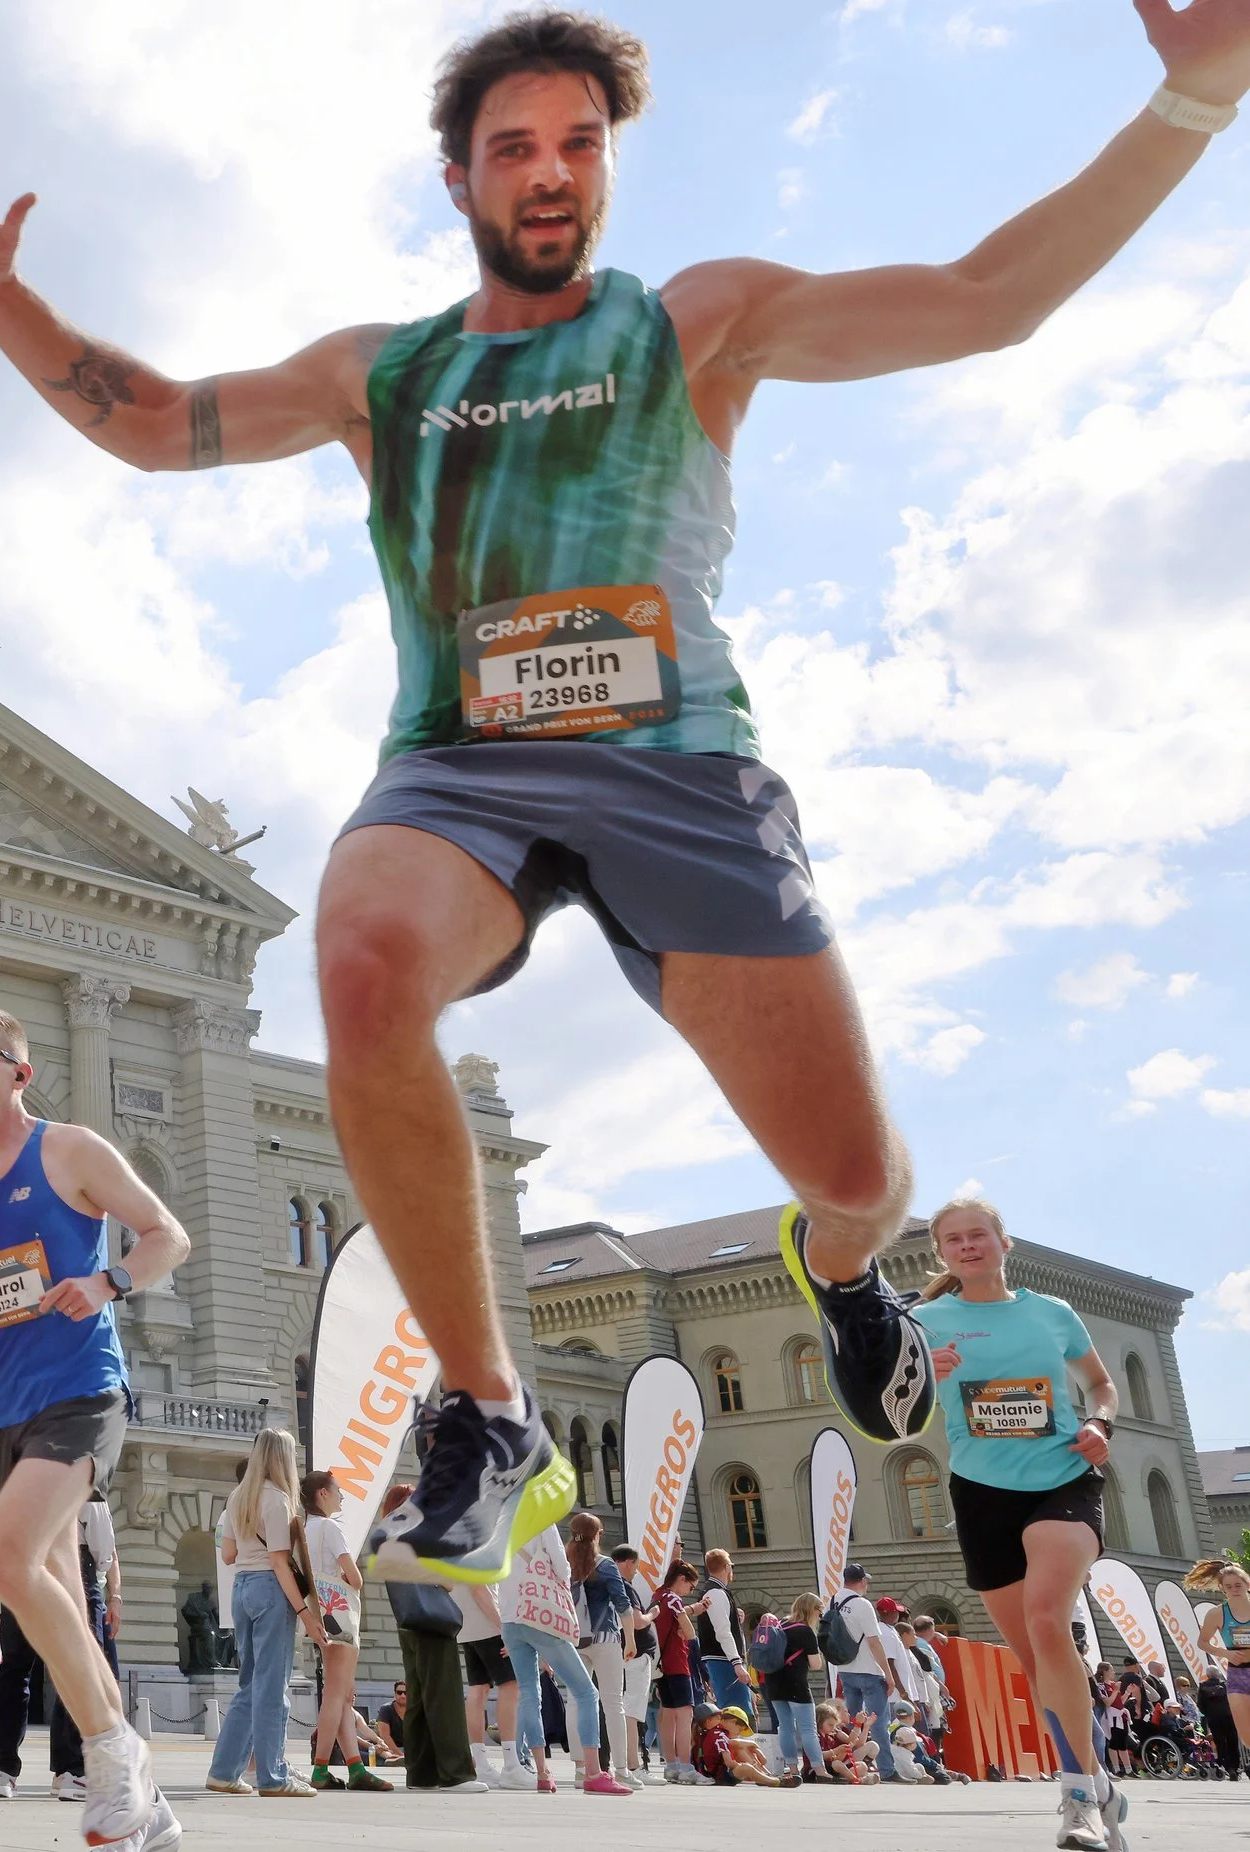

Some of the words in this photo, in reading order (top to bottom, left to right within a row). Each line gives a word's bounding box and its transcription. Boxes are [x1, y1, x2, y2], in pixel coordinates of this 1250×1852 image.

[420, 373, 615, 437] Normal
[475, 609, 572, 643] CRAFT
[515, 646, 621, 684] Florin
[493, 704, 519, 721] A2
[530, 682, 610, 709] 23968
[329, 1307, 432, 1502] MIGRO
[978, 1402, 1042, 1416] Melanie
[996, 1418, 1027, 1427] 10819
[637, 1408, 696, 1593] MIGROS
